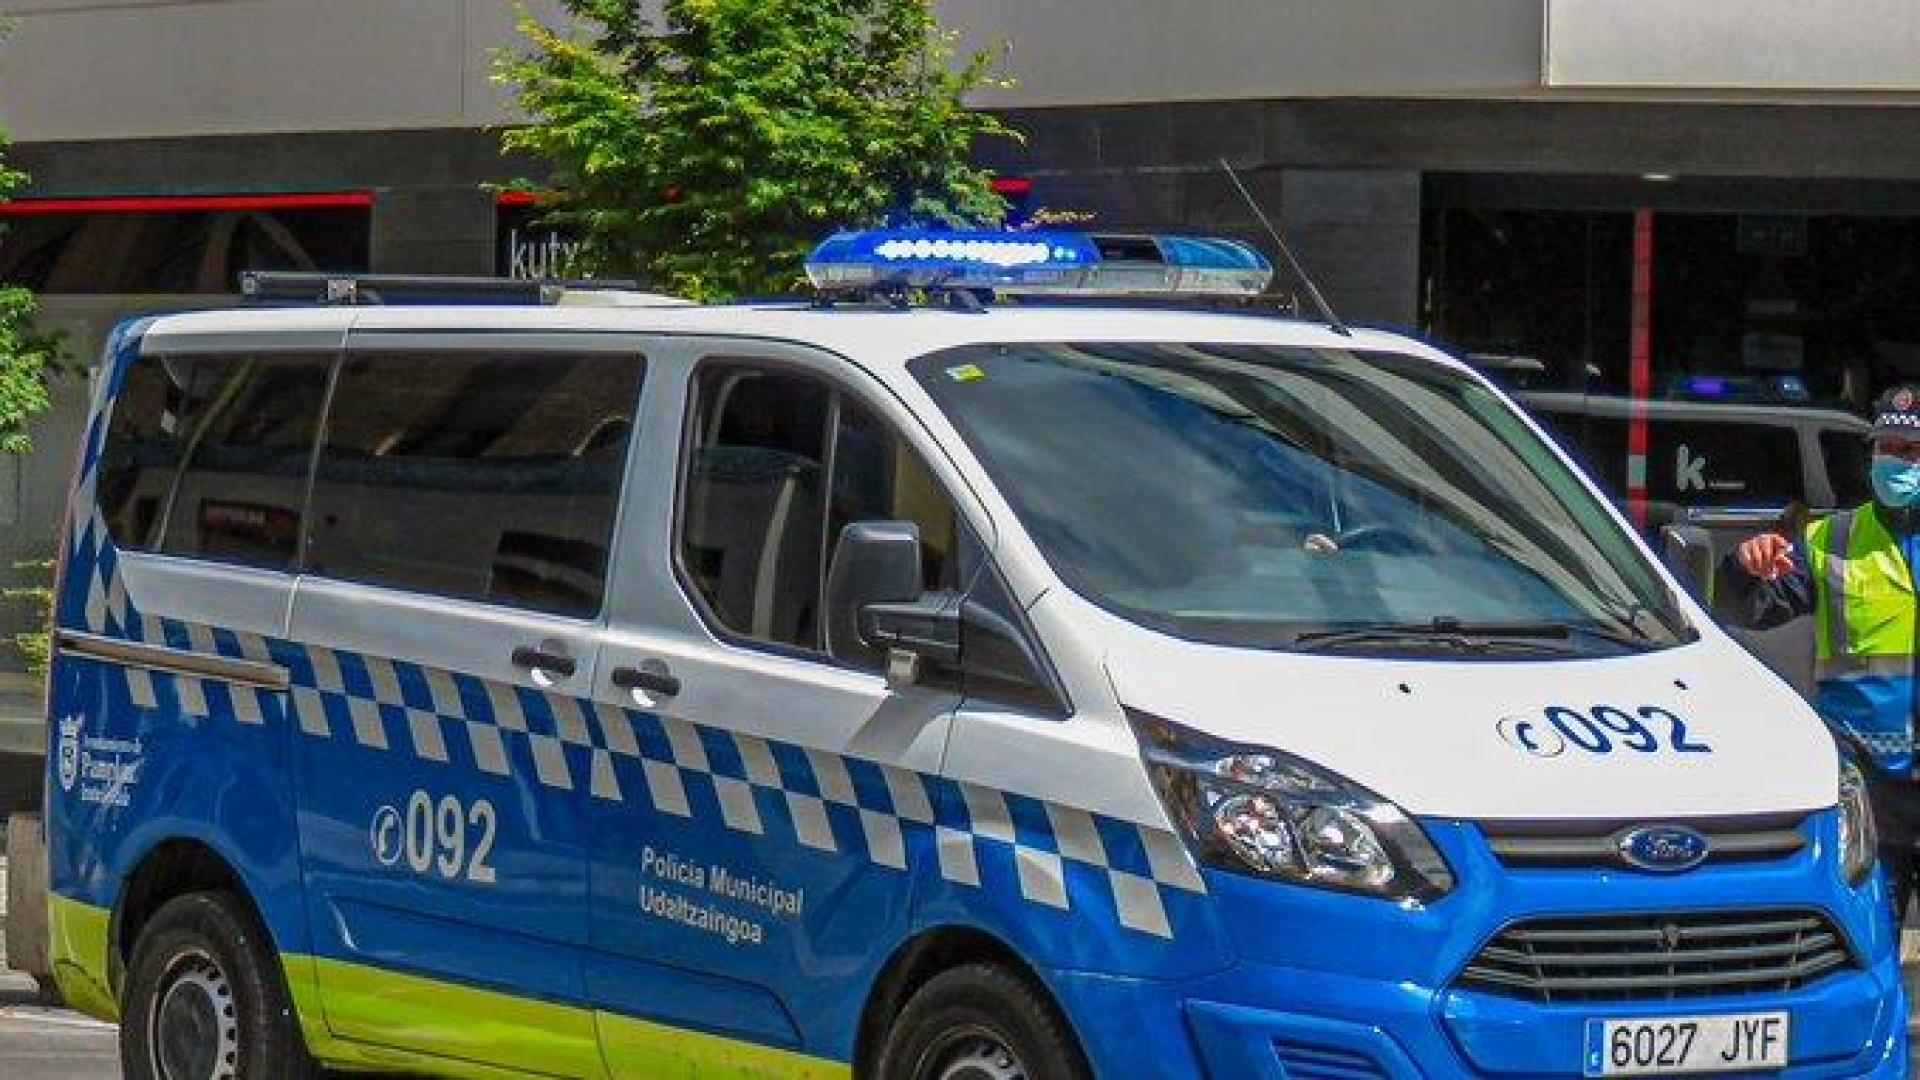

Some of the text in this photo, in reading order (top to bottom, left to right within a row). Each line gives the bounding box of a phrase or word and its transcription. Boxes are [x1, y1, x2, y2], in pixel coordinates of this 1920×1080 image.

[1677, 444, 1705, 490] k
[1544, 706, 1711, 752] 092
[406, 790, 496, 883] 092
[709, 865, 803, 914] Municipal
[640, 885, 762, 943] Udaltzaingoa
[1611, 1023, 1697, 1066] 6027
[1721, 1018, 1780, 1061] JYF
